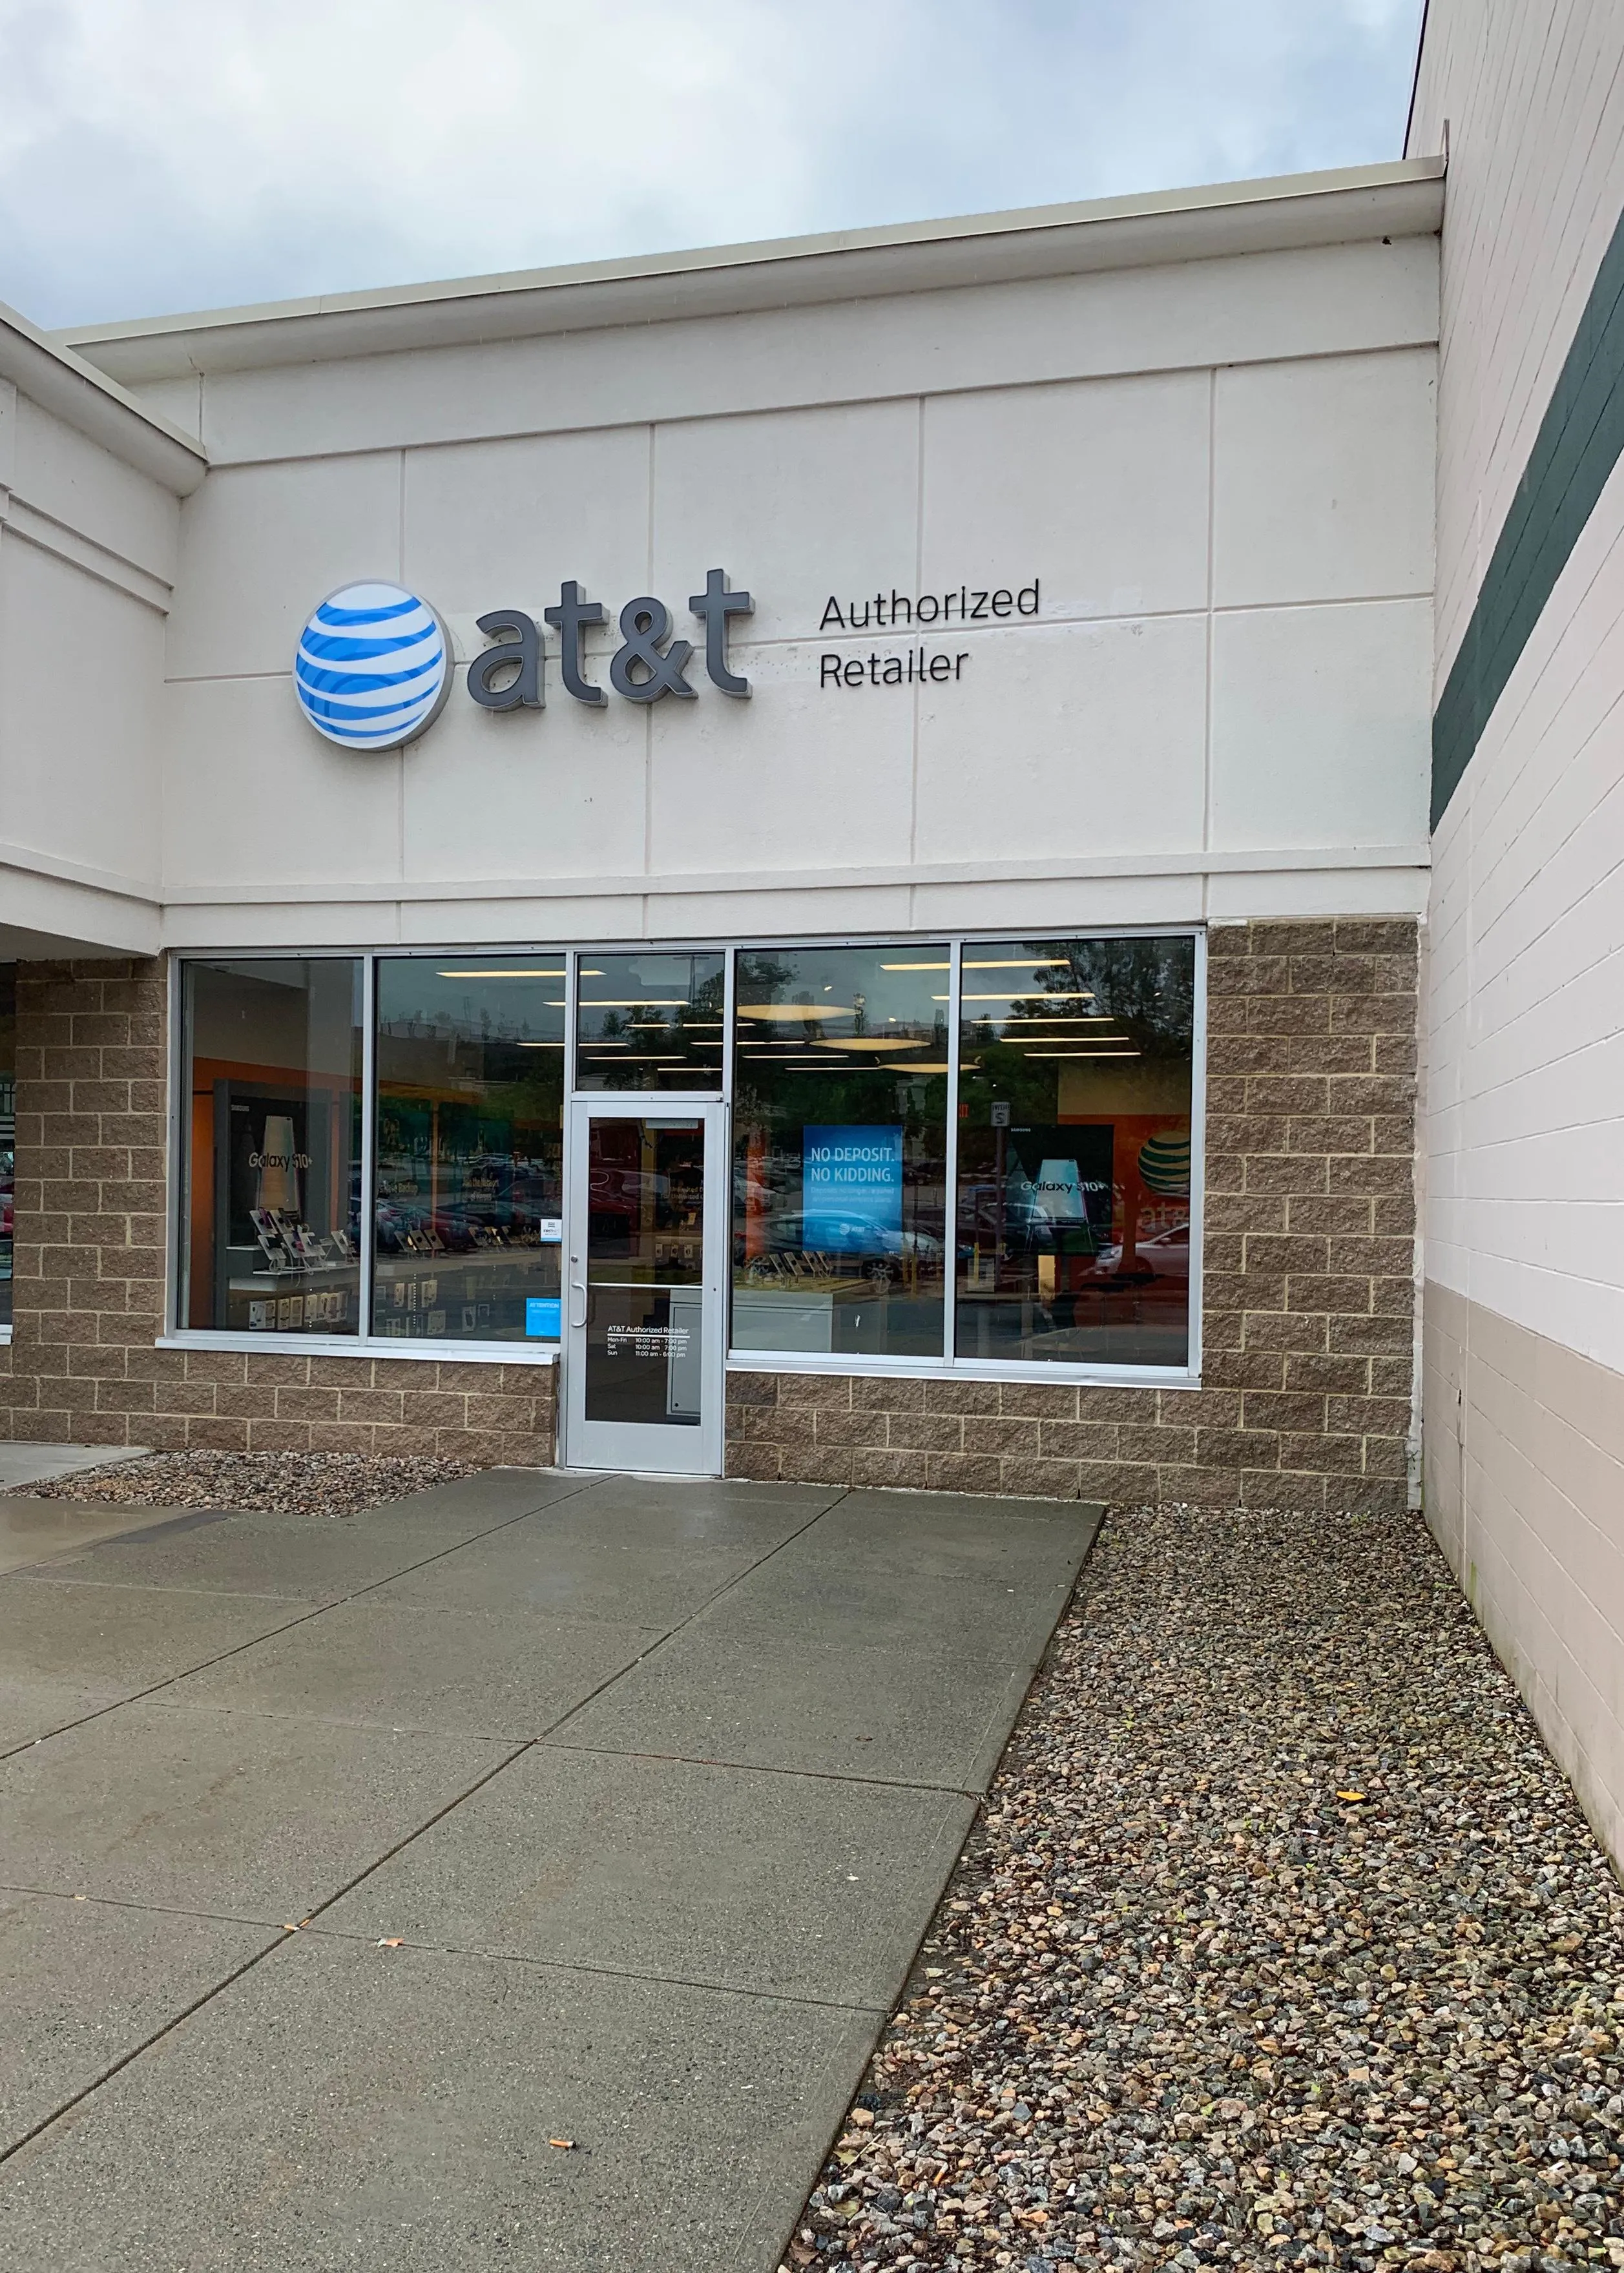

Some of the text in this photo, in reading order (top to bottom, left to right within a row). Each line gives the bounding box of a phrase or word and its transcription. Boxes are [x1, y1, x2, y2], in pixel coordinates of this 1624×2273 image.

[819, 578, 1039, 630] Authorized
[467, 568, 755, 711] at&t
[820, 647, 969, 688] Retailer
[249, 1152, 313, 1172] Galaxy S10+
[811, 1147, 895, 1162] NO DEPOSIT.
[811, 1167, 895, 1182] NO KIDDING.
[1021, 1181, 1104, 1194] Galaxy S10+
[626, 1325, 663, 1334] Authorized
